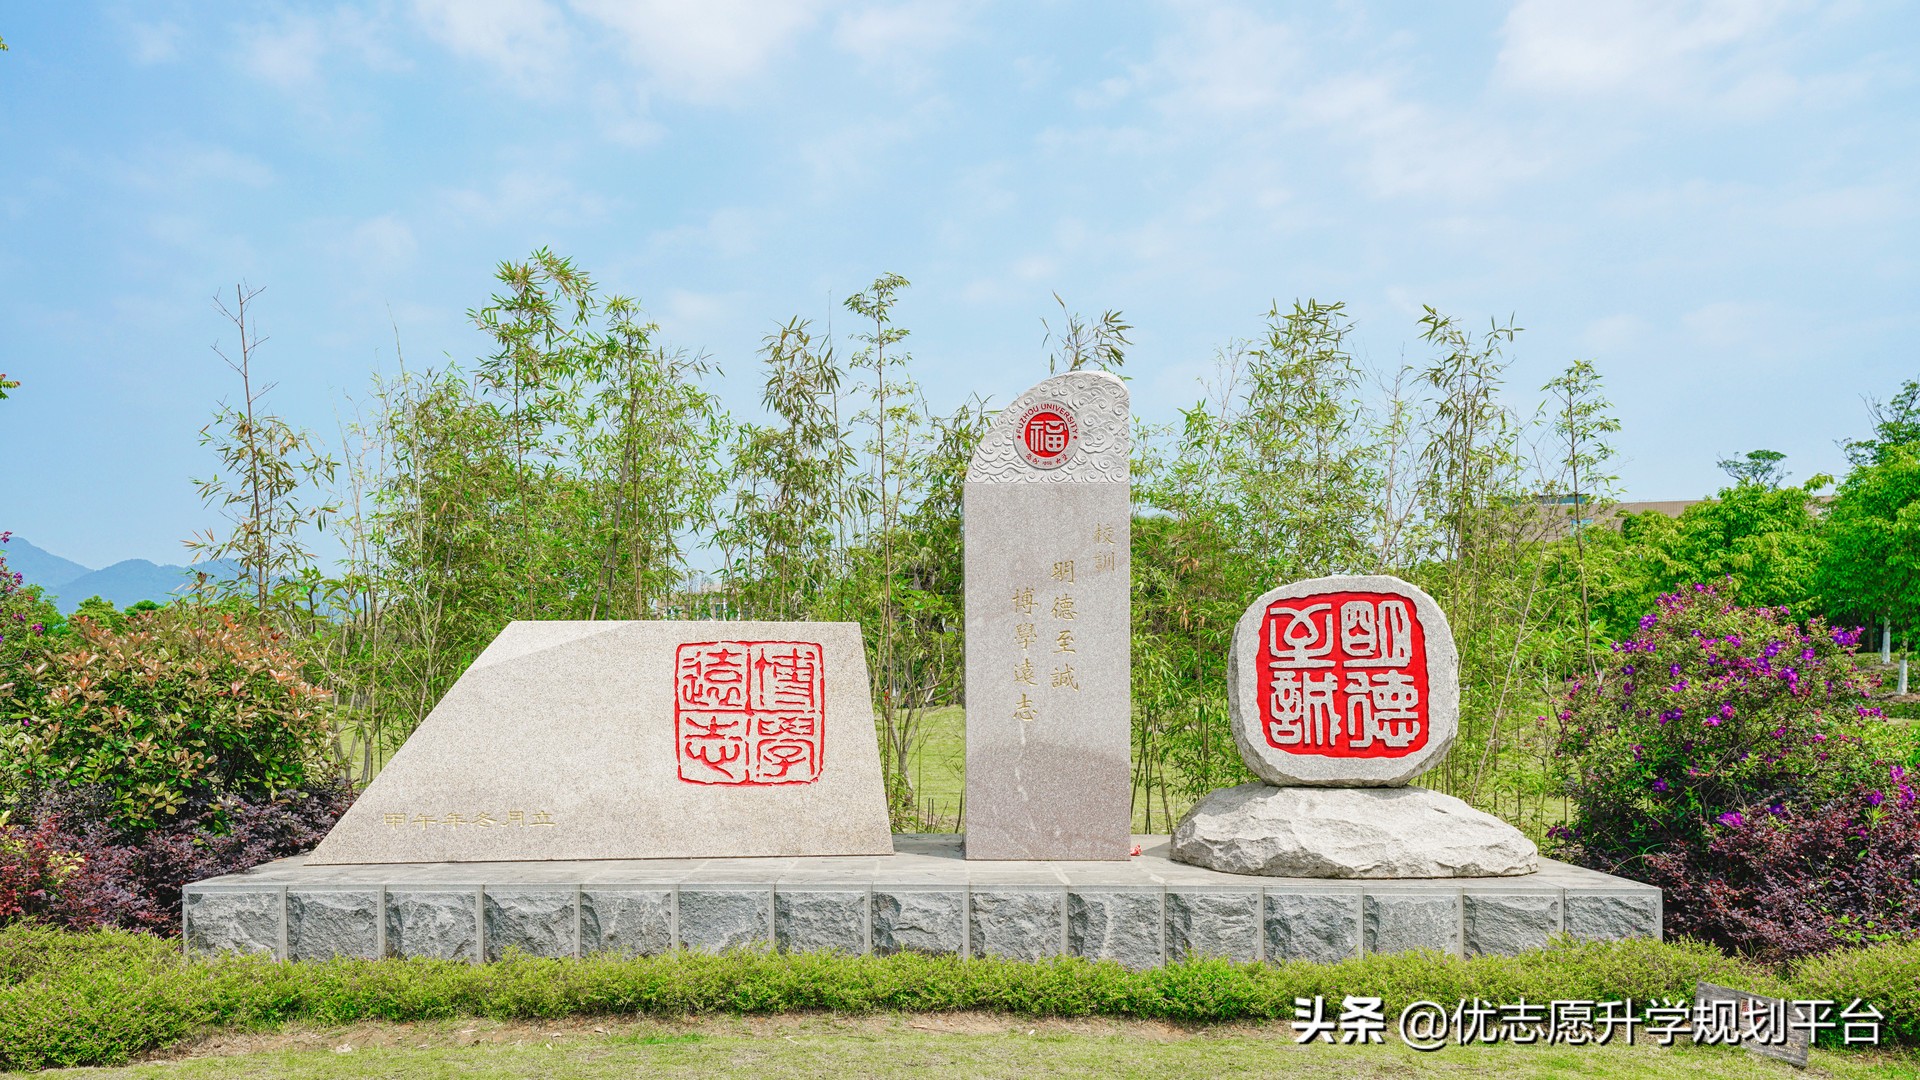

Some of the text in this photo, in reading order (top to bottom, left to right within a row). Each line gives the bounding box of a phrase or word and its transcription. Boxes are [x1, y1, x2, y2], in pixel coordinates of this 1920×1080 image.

[1016, 403, 1078, 434] FUZHOU UNIVERSITY
[1030, 420, 1068, 452] 福
[1012, 586, 1038, 721] 博學遠志
[383, 810, 558, 830] 甲午年冬月立
